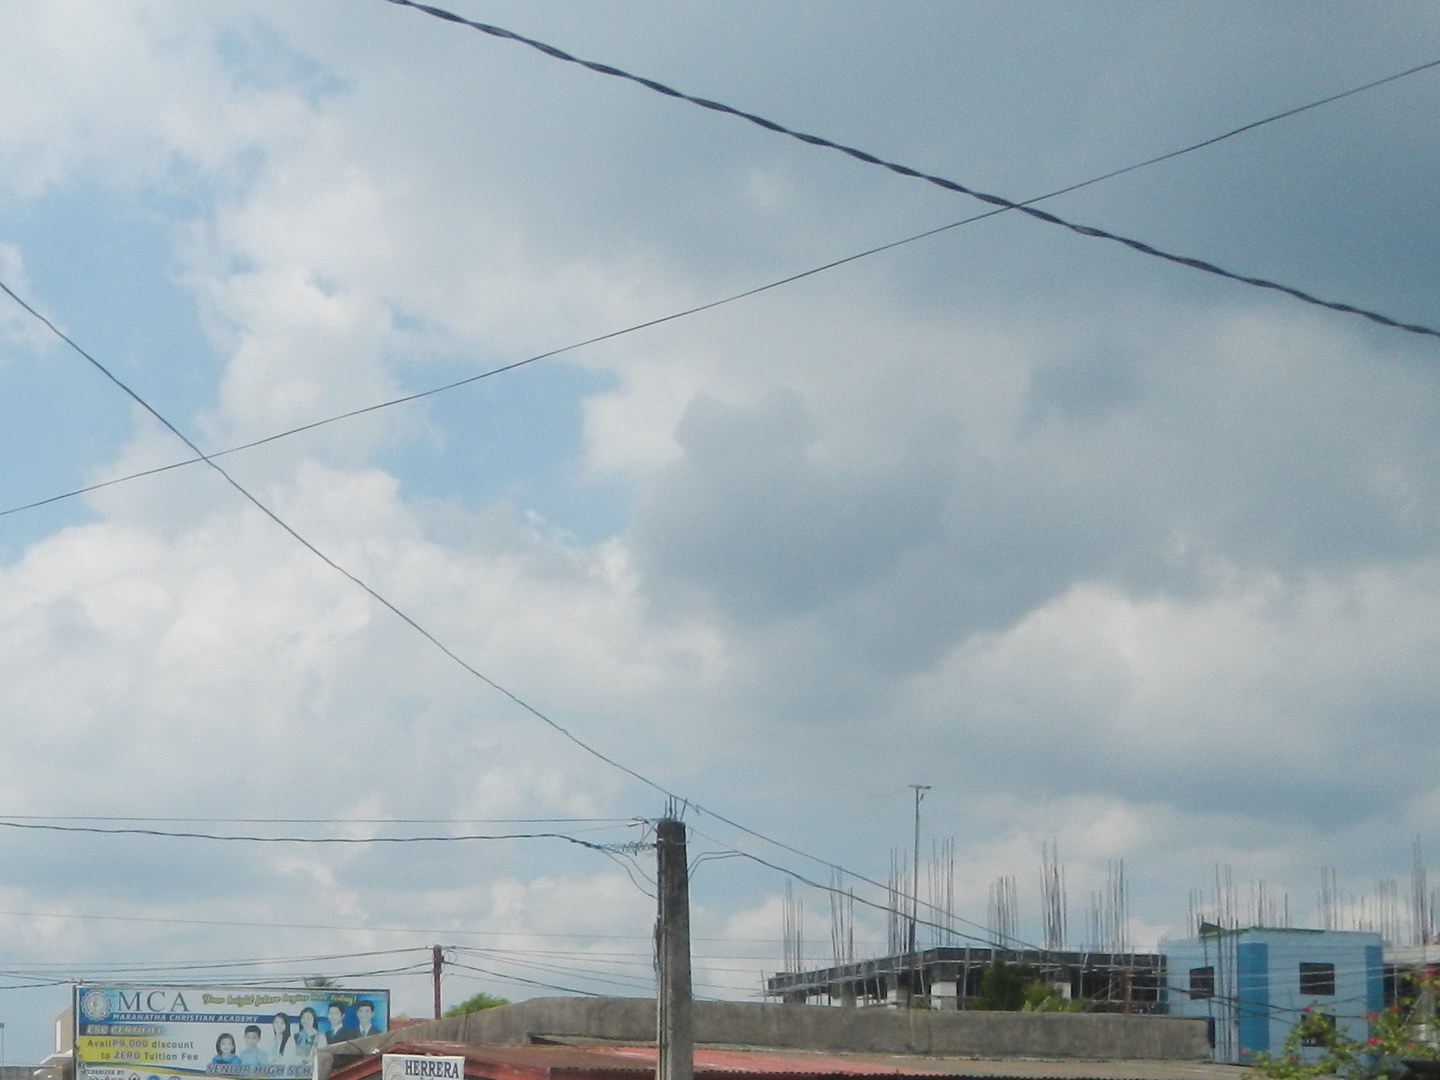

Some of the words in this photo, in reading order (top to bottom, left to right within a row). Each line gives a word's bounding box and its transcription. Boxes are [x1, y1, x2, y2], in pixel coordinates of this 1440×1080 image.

[118, 991, 189, 1012] MCA
[168, 1014, 215, 1022] CHRISTIAN
[217, 1015, 259, 1023] ACADEMY
[87, 1024, 108, 1034] ESC
[110, 1025, 166, 1035] CERTIFIED
[151, 1040, 194, 1049] discount
[114, 1052, 140, 1060] ZERO
[144, 1053, 178, 1061] Tuition
[181, 1053, 199, 1061] Fee
[206, 1063, 253, 1075] SENIOR
[254, 1065, 285, 1075] HIGH
[405, 1060, 459, 1079] HERRERA
